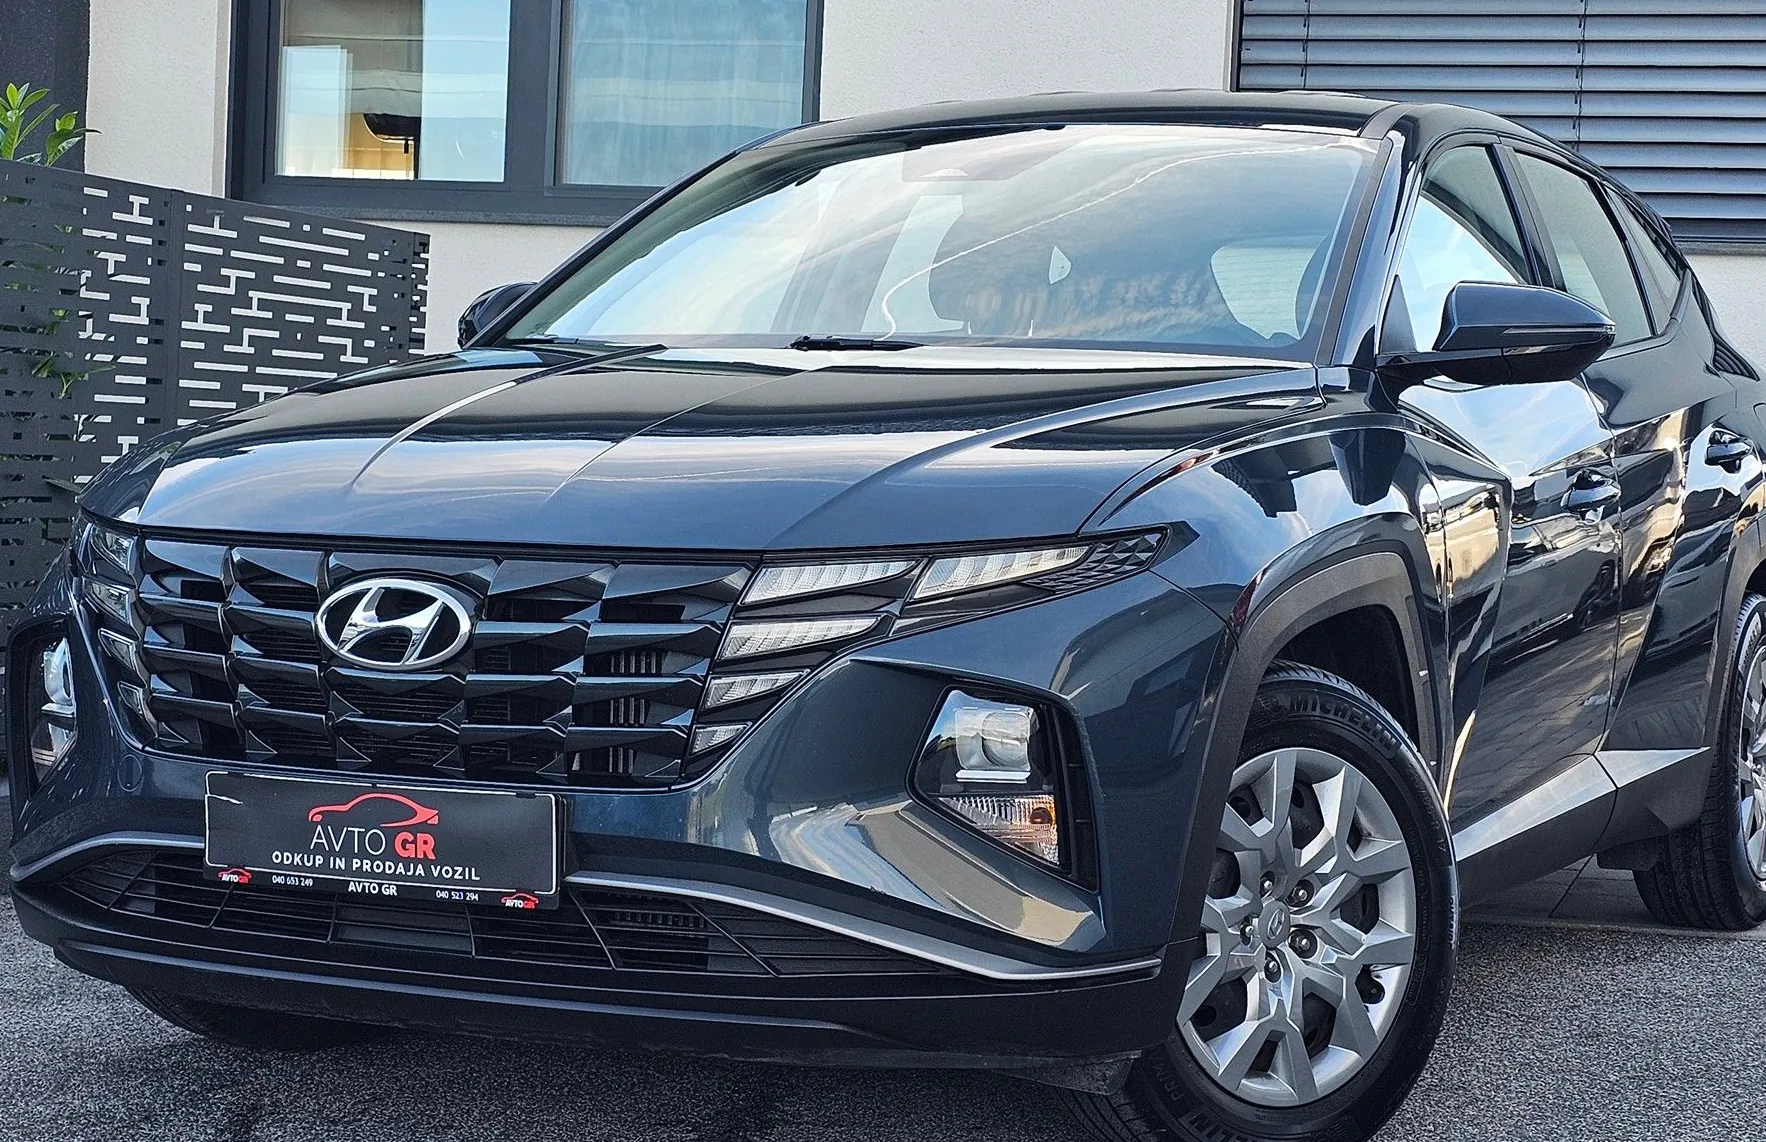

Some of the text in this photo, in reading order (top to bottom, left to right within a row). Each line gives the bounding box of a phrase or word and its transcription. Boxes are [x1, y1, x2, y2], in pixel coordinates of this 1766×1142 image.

[1288, 694, 1403, 750] MICHELIN
[309, 823, 436, 860] AVTO GR
[271, 850, 481, 881] ODKUP IN PRODAJA VOZIL
[271, 874, 314, 887] 040 653 249
[347, 880, 398, 897] AVTO GR
[435, 889, 479, 902] 040 523 294
